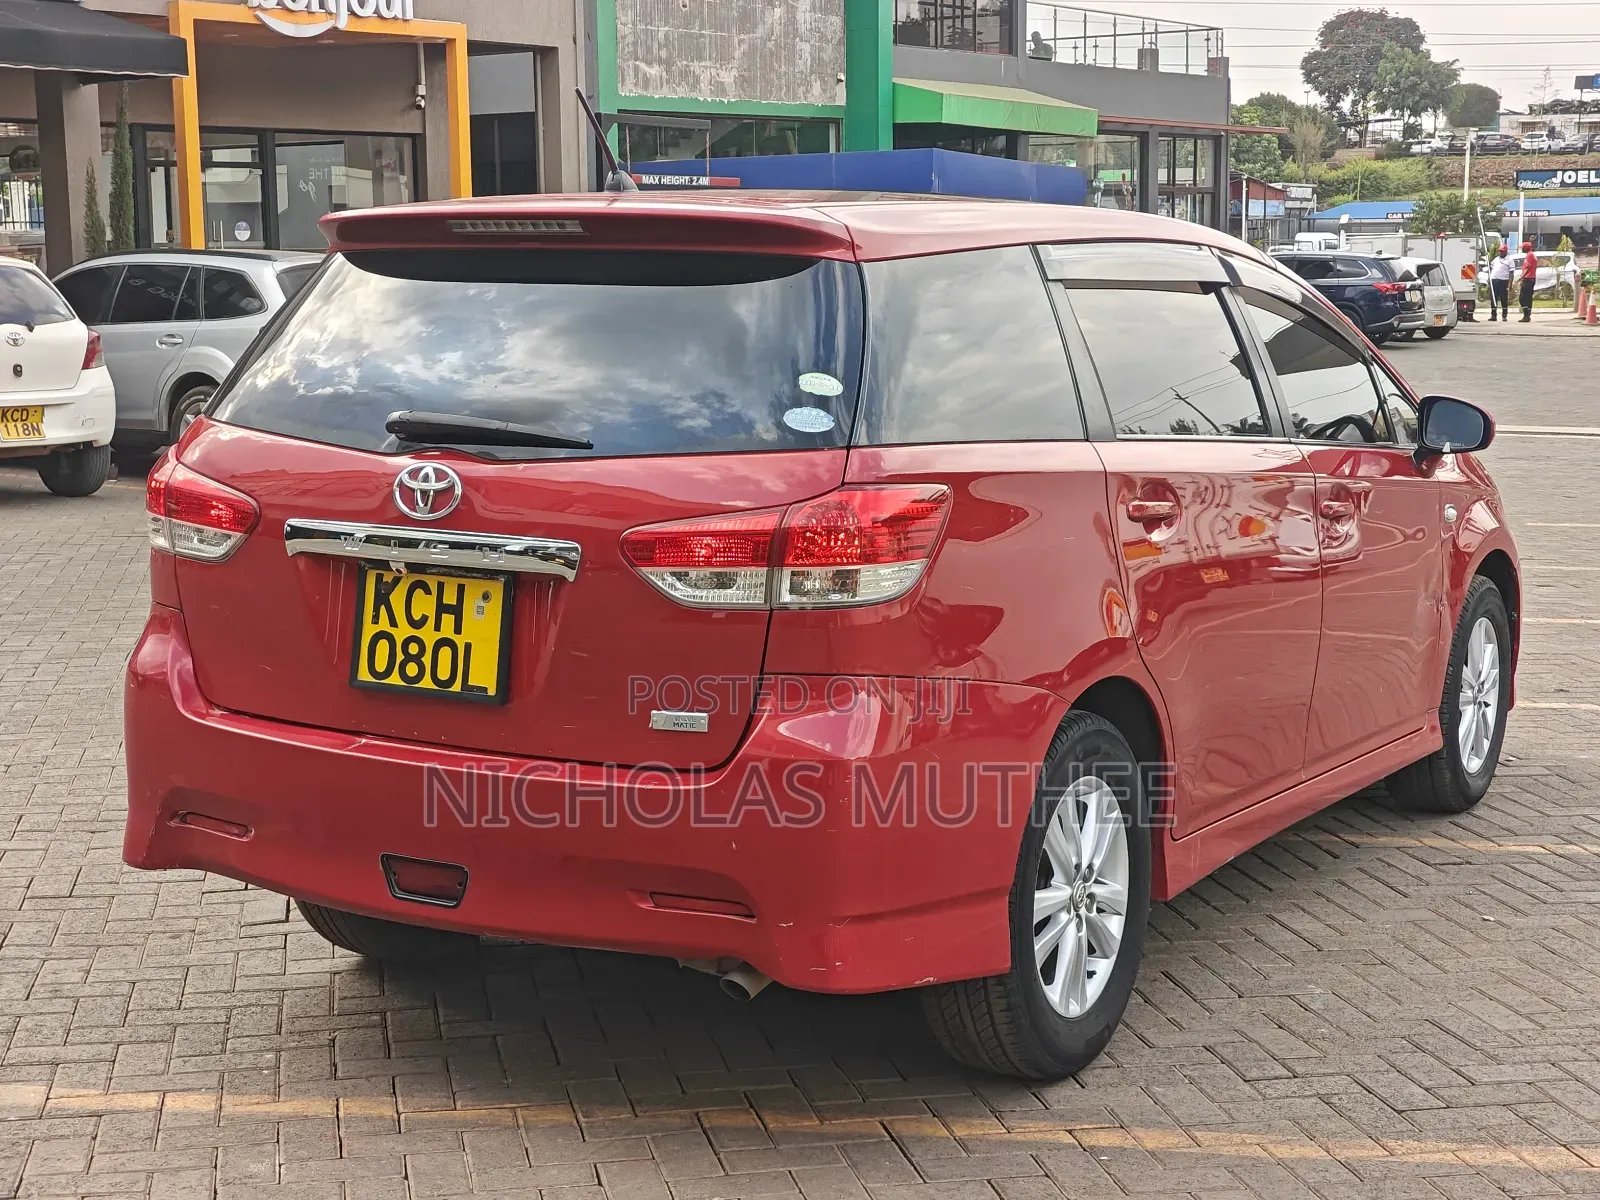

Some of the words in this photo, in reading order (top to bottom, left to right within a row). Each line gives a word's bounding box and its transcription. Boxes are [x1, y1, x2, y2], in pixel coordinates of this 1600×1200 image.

[642, 175, 659, 185] MAX
[692, 177, 709, 186] 2.4M
[1551, 170, 1600, 184] JOEL
[1, 408, 30, 423] KCD
[4, 422, 42, 437] 118N
[370, 573, 467, 635] KCH
[366, 630, 489, 695] 080L
